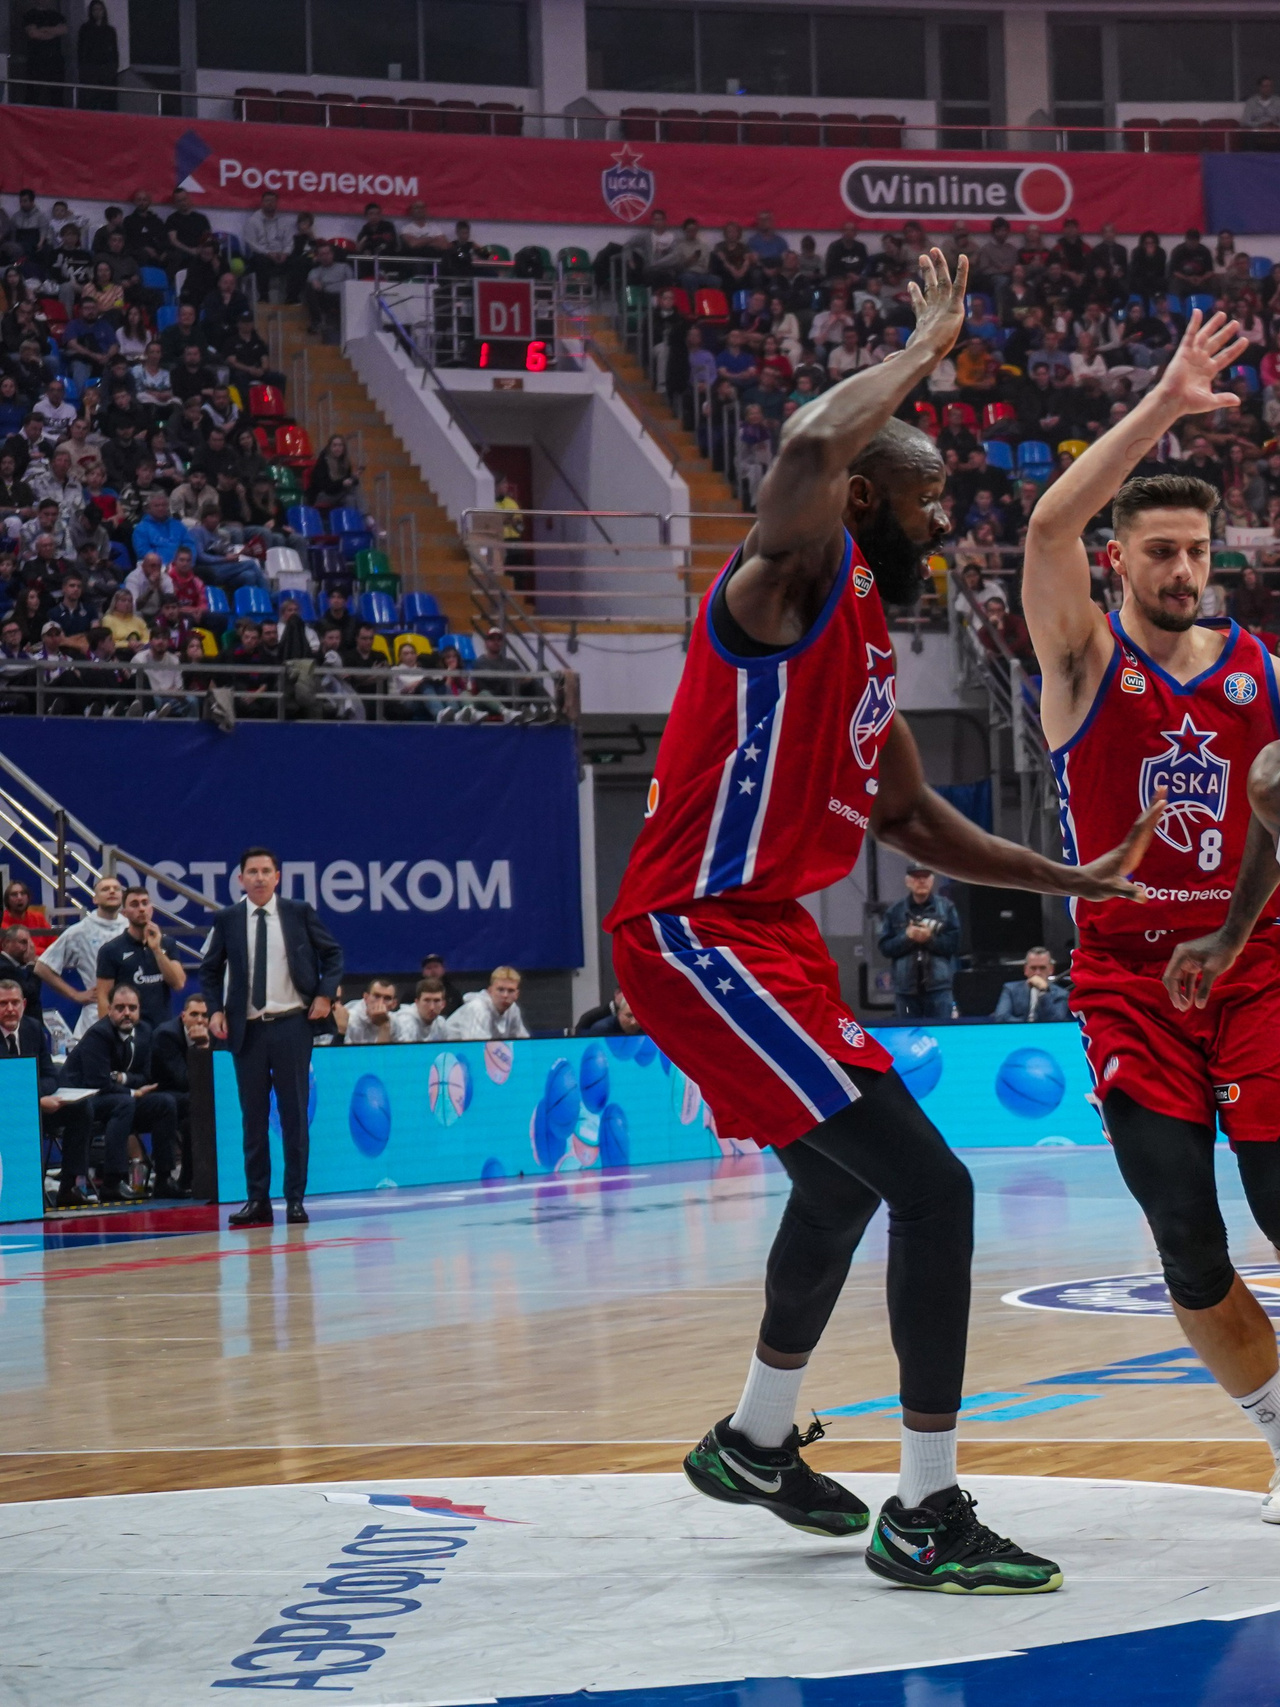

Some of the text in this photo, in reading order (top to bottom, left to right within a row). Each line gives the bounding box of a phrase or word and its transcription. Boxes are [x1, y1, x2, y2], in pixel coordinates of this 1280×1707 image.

[219, 159, 419, 197] Ростелеком
[607, 175, 649, 191] ЦСКА
[861, 174, 1007, 206] Winline
[489, 301, 521, 333] D1
[526, 341, 546, 372] 6
[855, 576, 870, 591] Win
[1127, 676, 1144, 687] Win
[1153, 771, 1219, 794] CSKA
[1198, 828, 1223, 871] 8
[40, 841, 512, 914] Ростлеком
[210, 1523, 478, 1693] АЭРОФЛОТ
